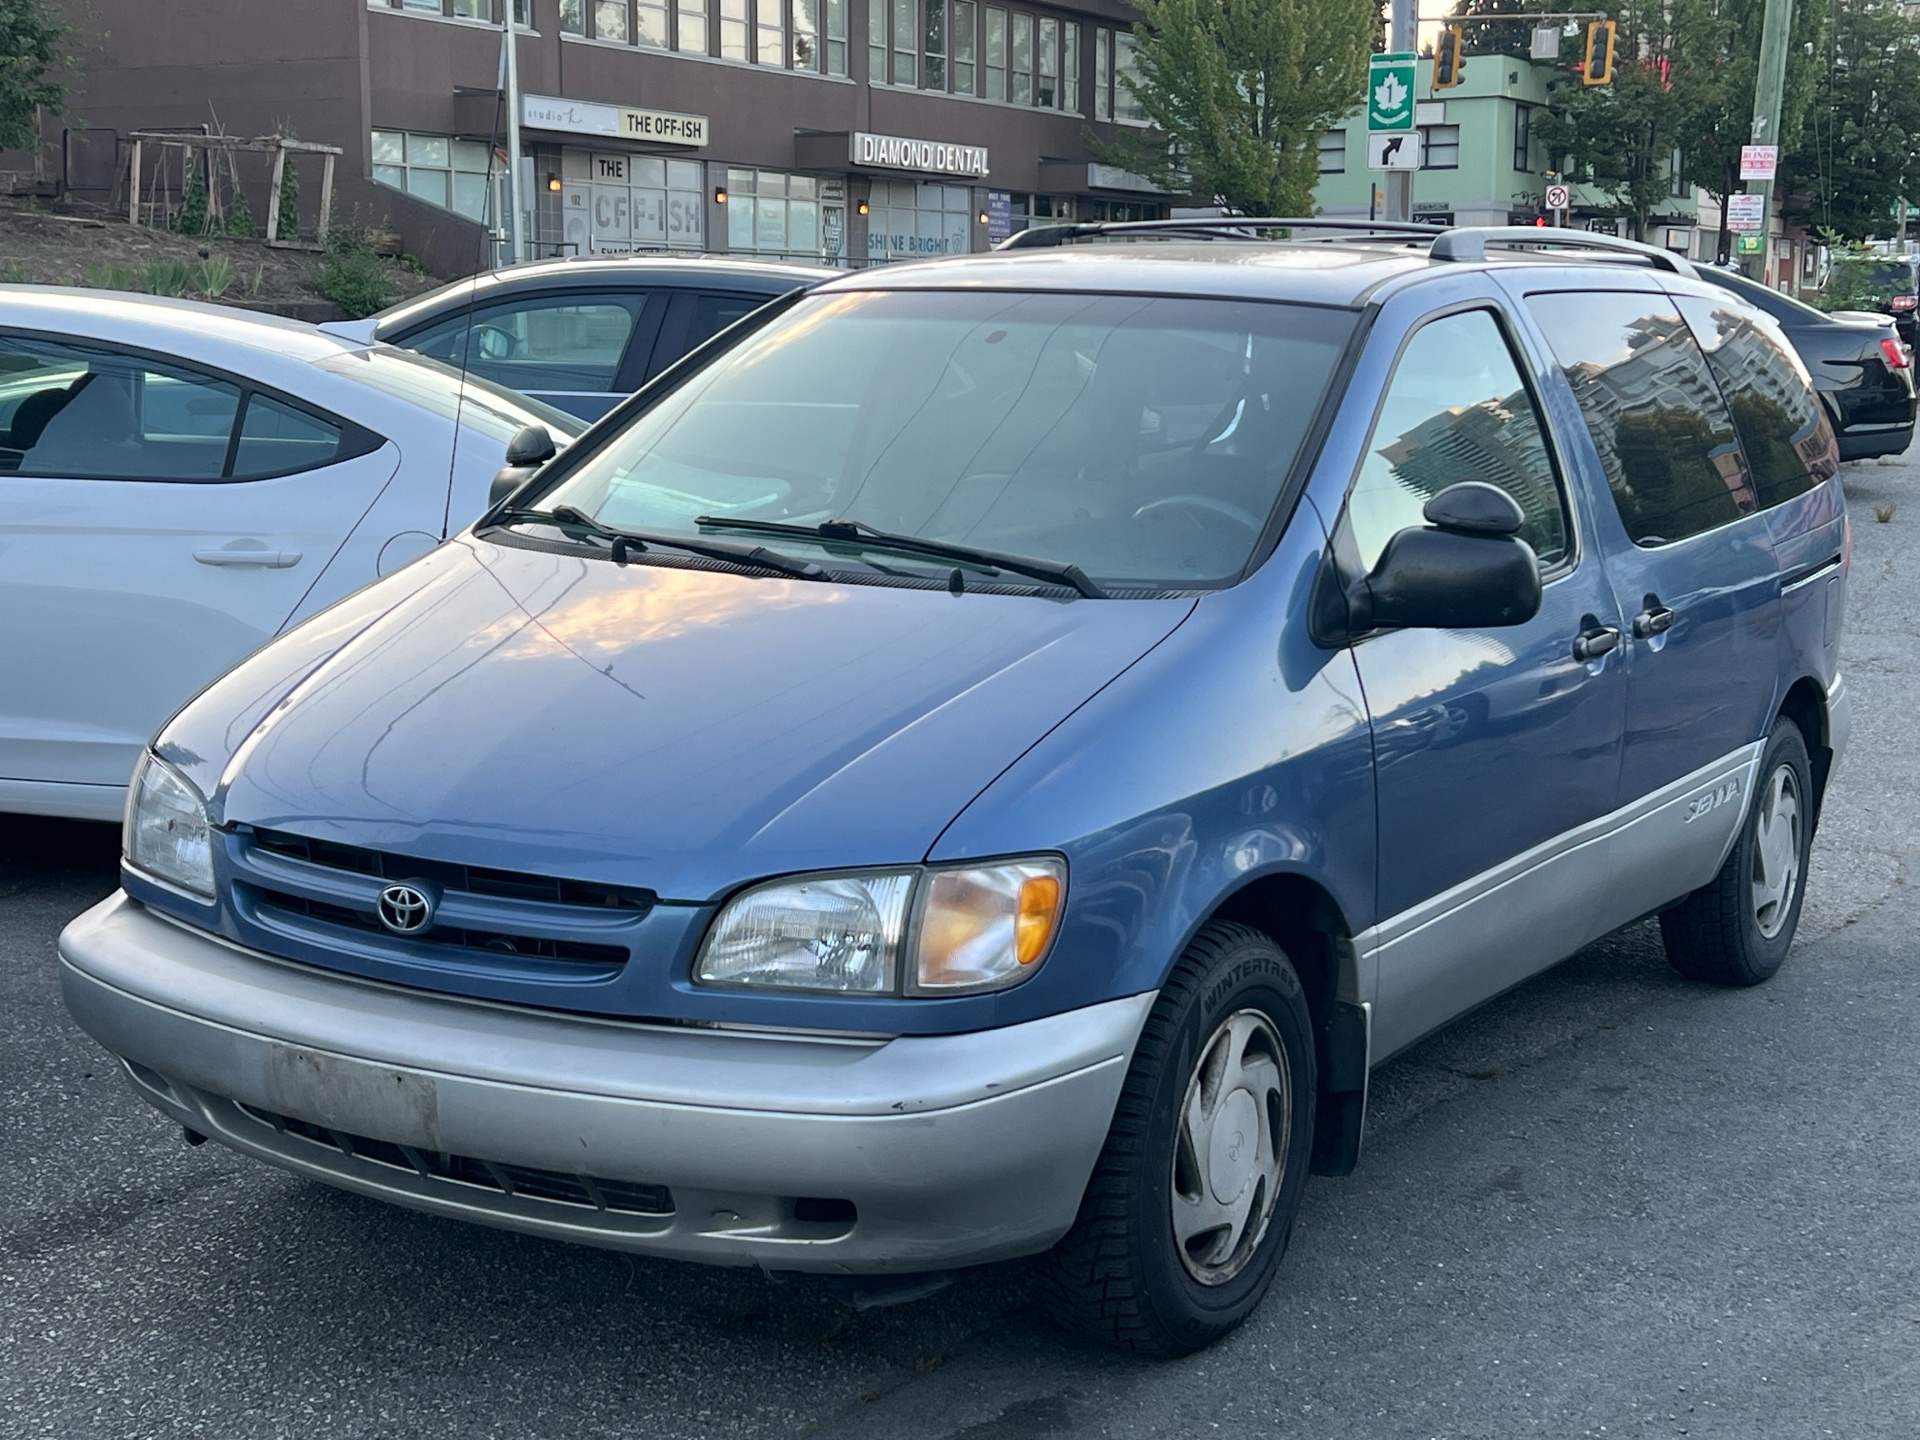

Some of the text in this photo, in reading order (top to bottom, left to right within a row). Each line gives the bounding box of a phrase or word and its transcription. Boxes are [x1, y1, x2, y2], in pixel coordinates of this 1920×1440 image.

[528, 110, 563, 121] studio
[627, 113, 702, 139] THE OFF-ISH
[864, 136, 990, 174] DIAMOND DENTAL
[598, 159, 623, 177] THE
[869, 233, 949, 253] SHINE BRIGHT
[1204, 957, 1296, 1015] WINTERTREK
